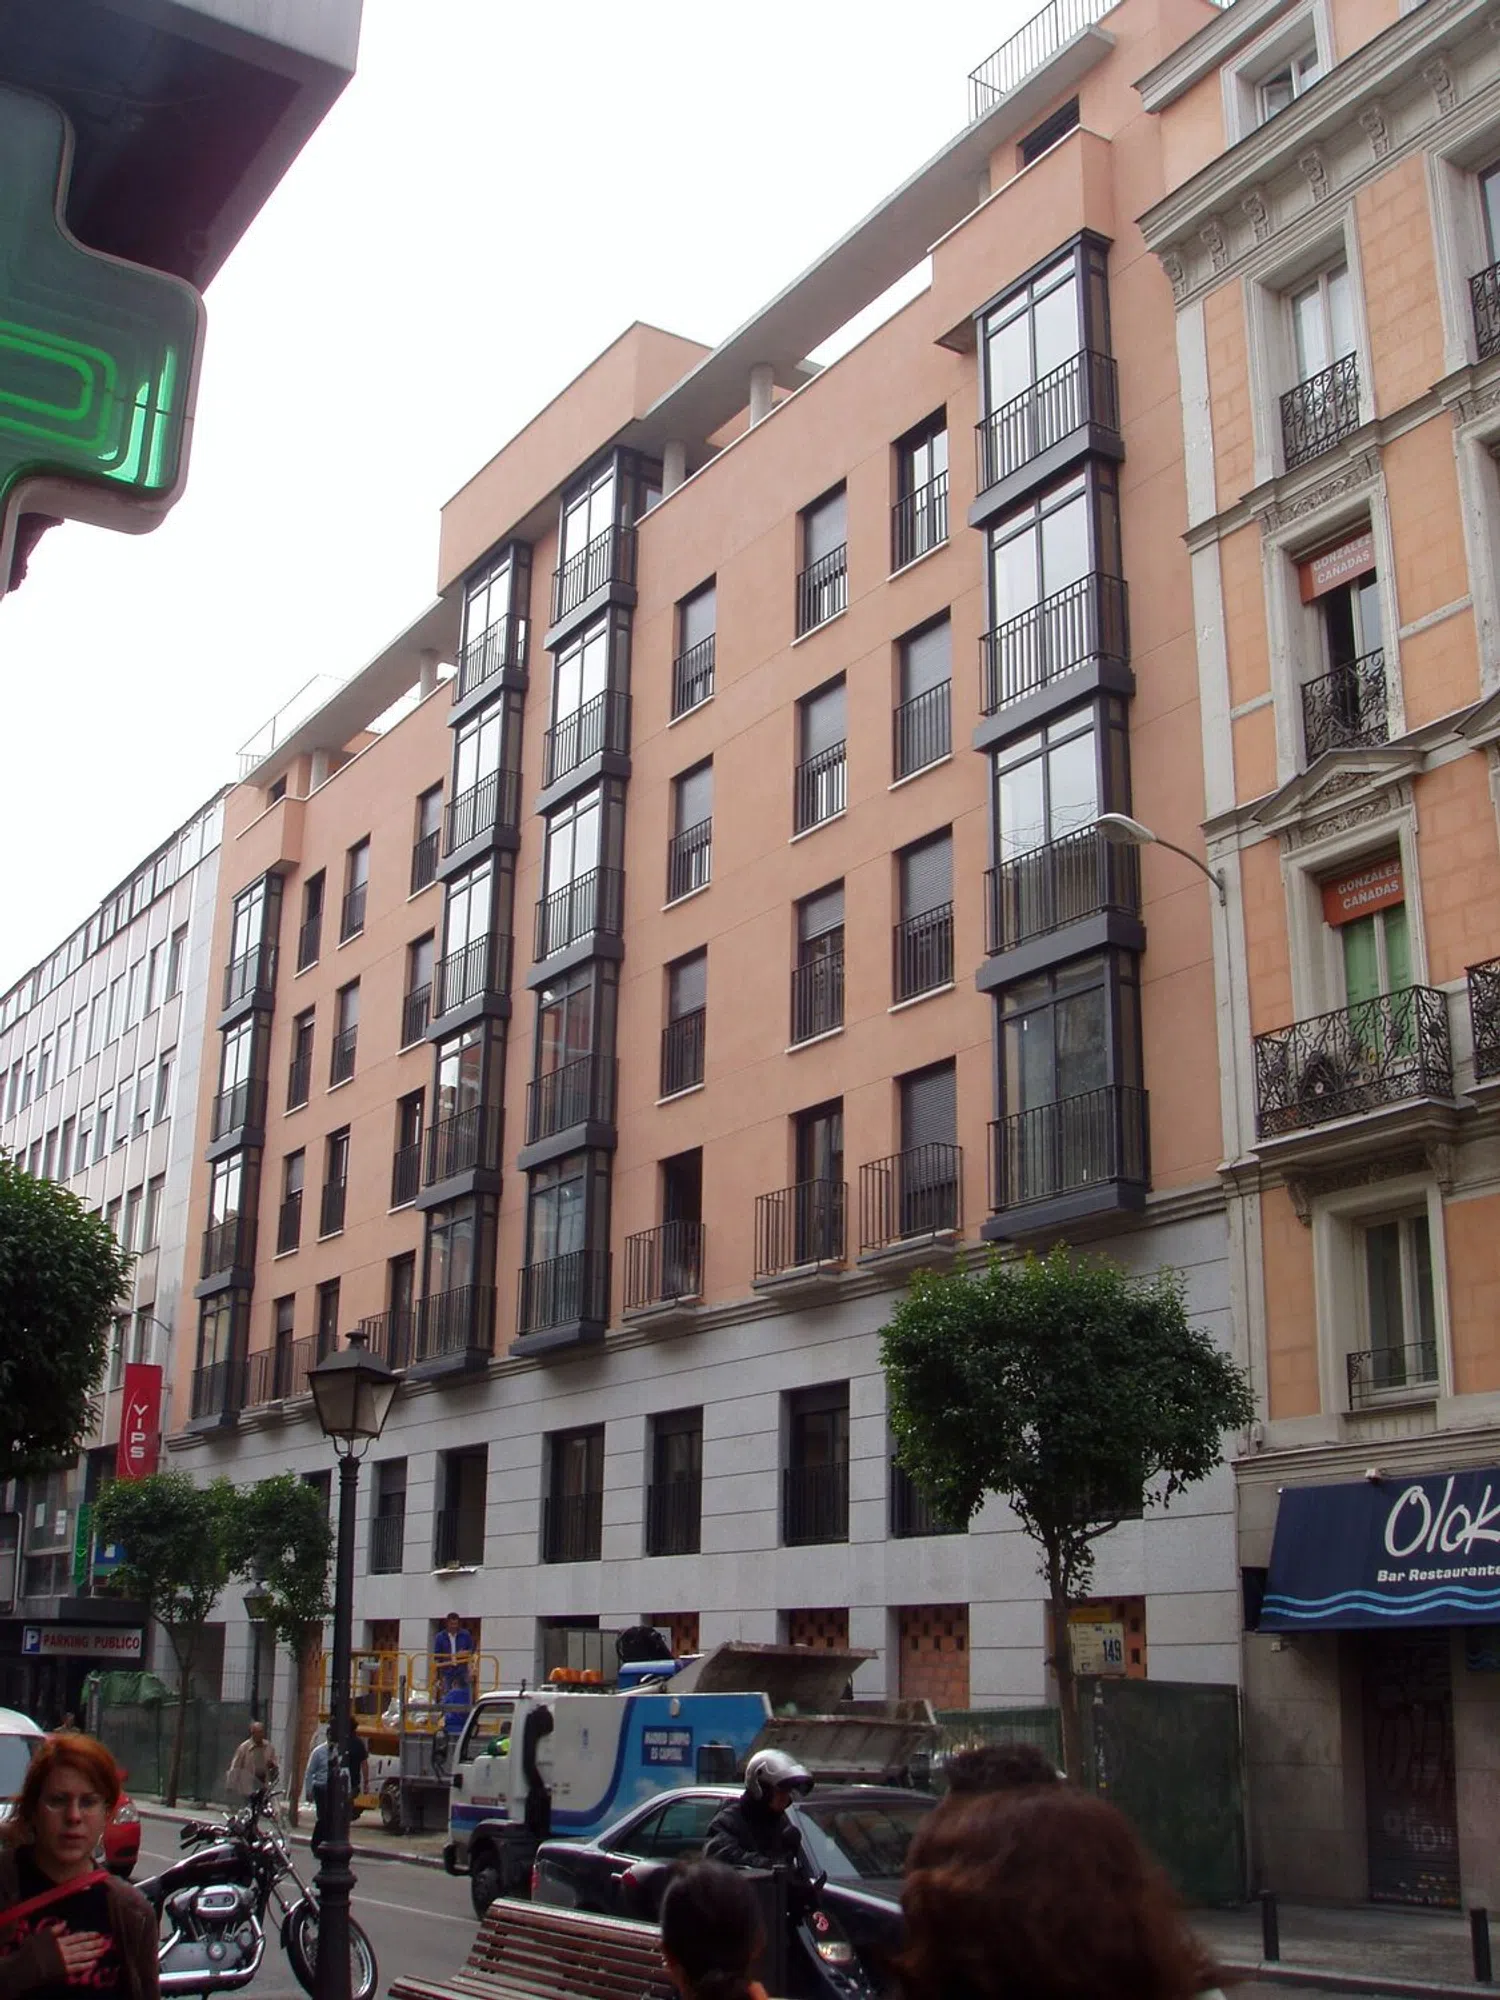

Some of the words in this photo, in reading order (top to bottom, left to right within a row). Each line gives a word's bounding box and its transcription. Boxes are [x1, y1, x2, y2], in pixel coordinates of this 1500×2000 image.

[1317, 549, 1370, 584] CAÑADAS
[1343, 880, 1399, 910] CAÑADAS
[130, 1404, 149, 1459] VIPS
[1377, 1569, 1405, 1582] Bar
[1409, 1564, 1500, 1581] Restaurante
[43, 1633, 89, 1649] PARKING
[1103, 1638, 1123, 1663] 149
